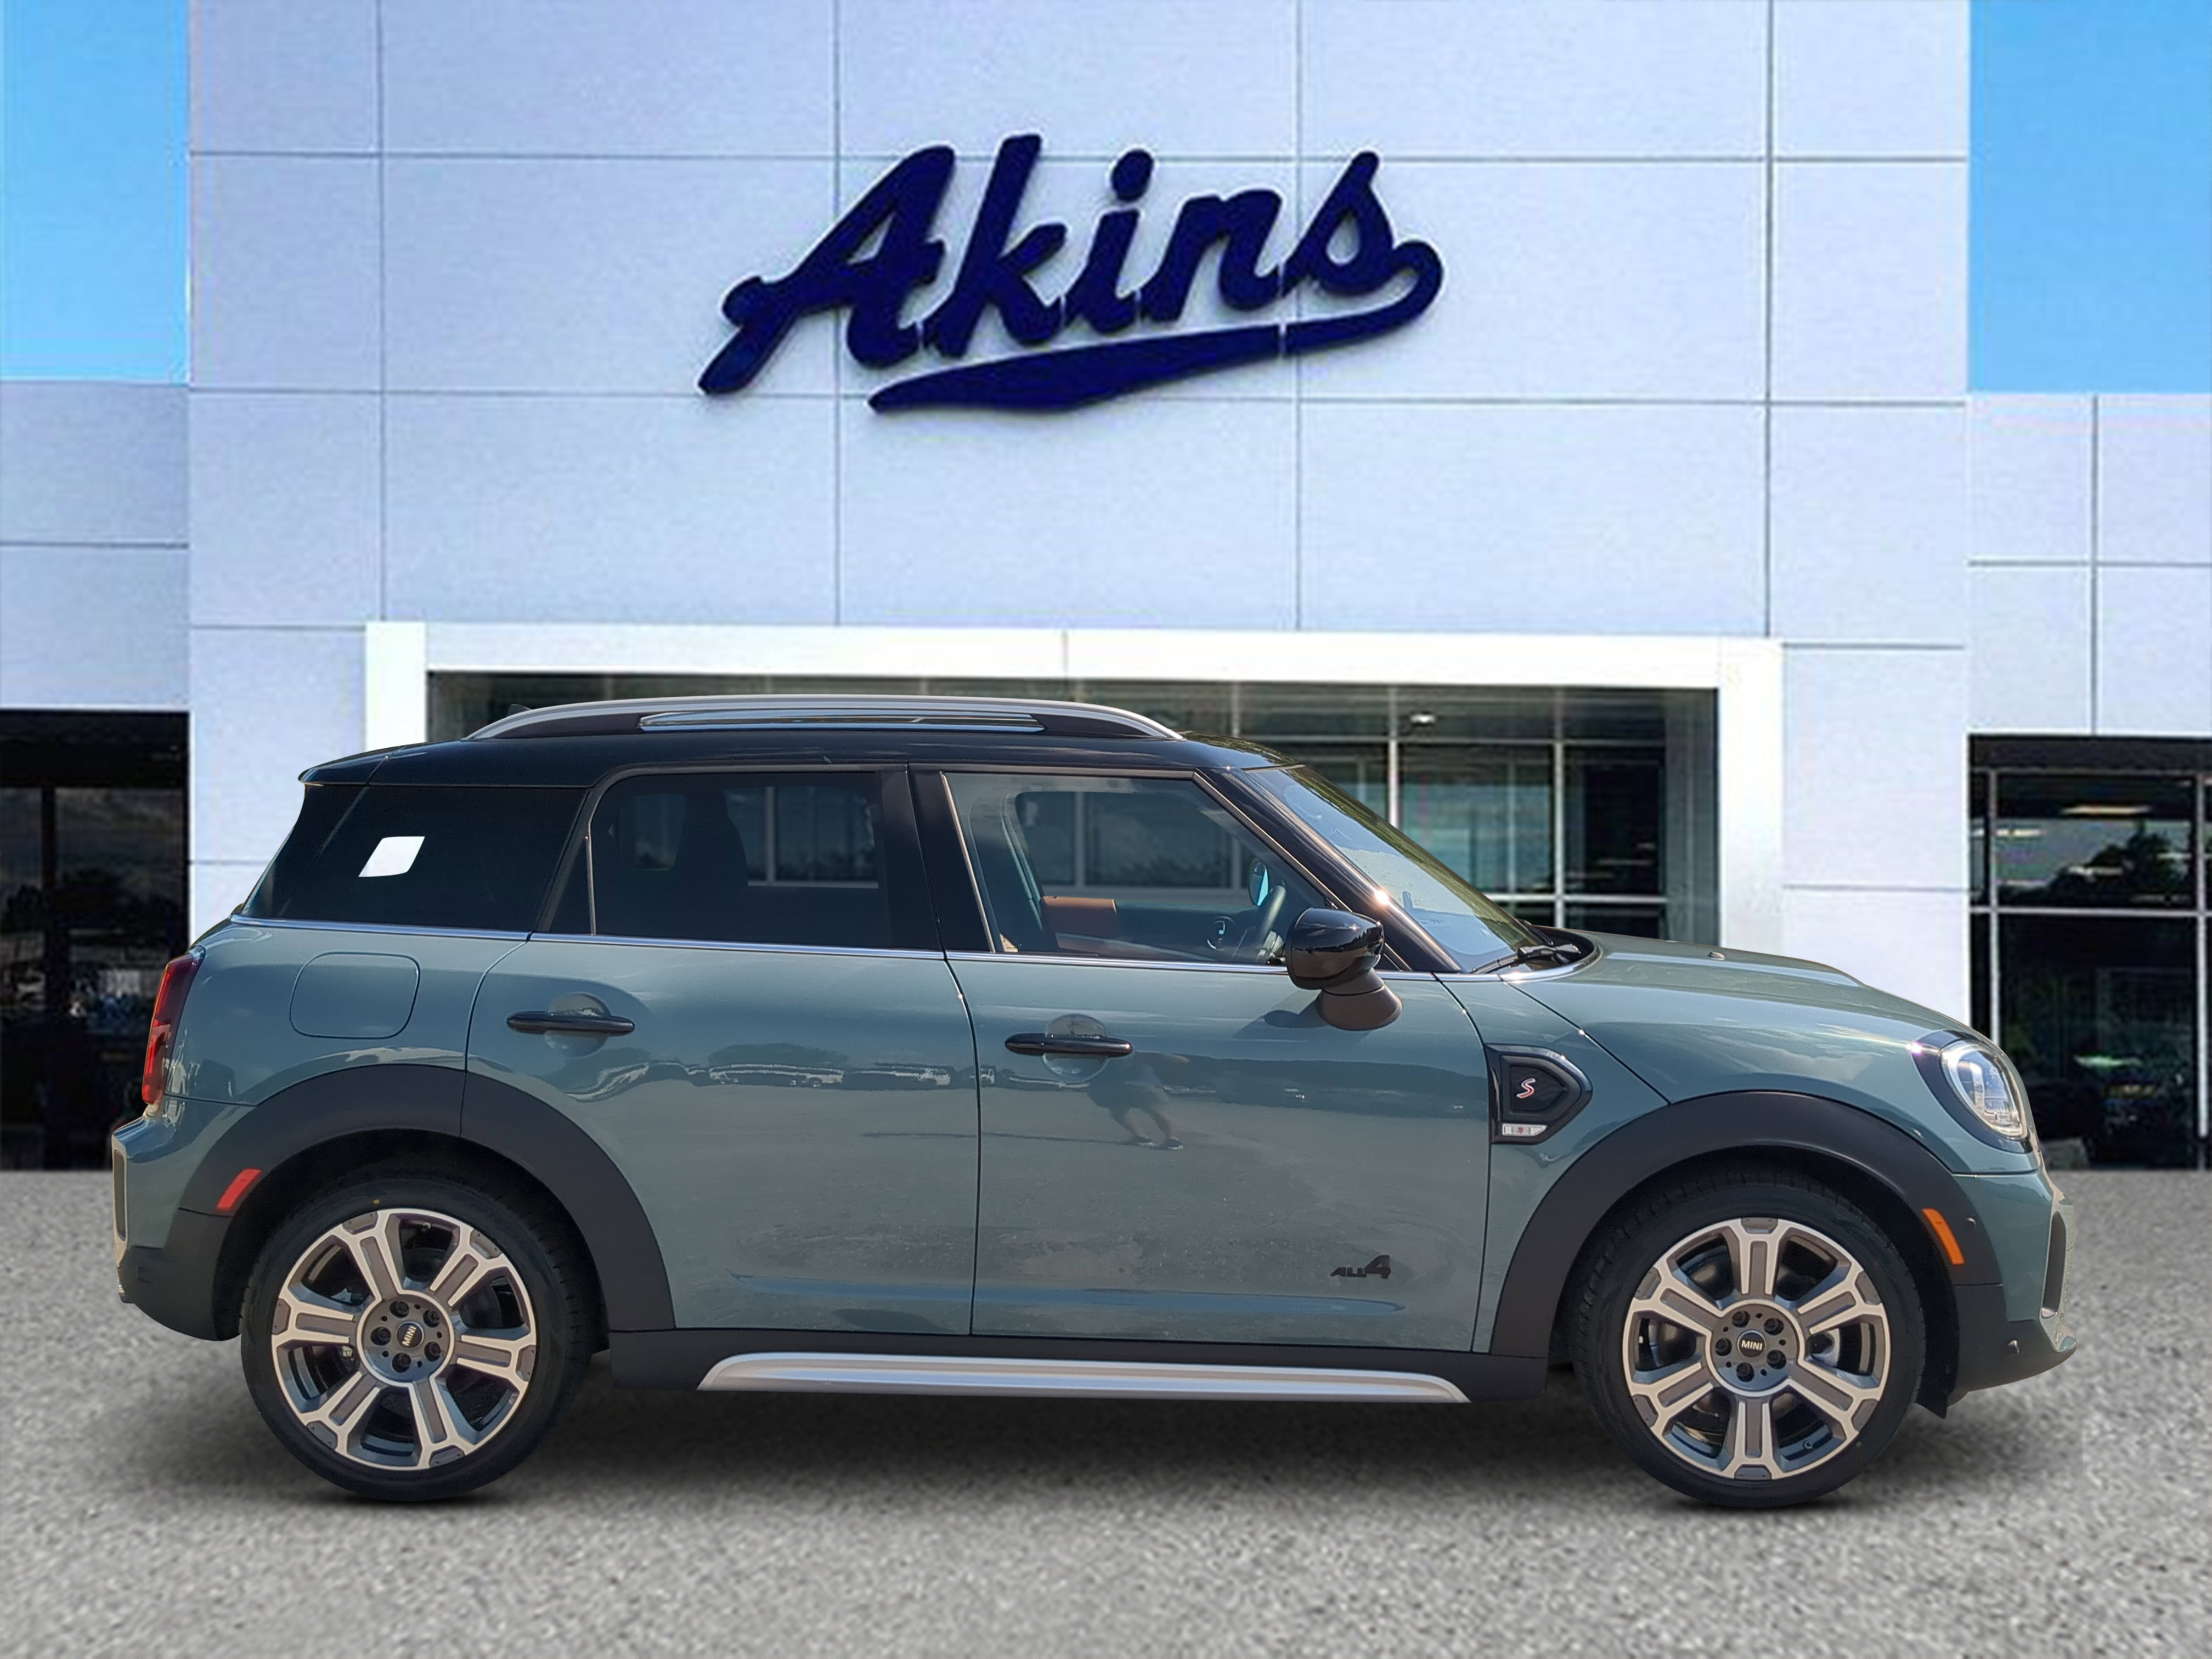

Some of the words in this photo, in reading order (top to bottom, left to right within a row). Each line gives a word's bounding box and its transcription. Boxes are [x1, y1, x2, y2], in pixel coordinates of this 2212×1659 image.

[699, 133, 1444, 413] Akins
[1516, 1078, 1536, 1099] S
[402, 1325, 416, 1346] MINI
[1741, 1340, 1763, 1351] MINI
